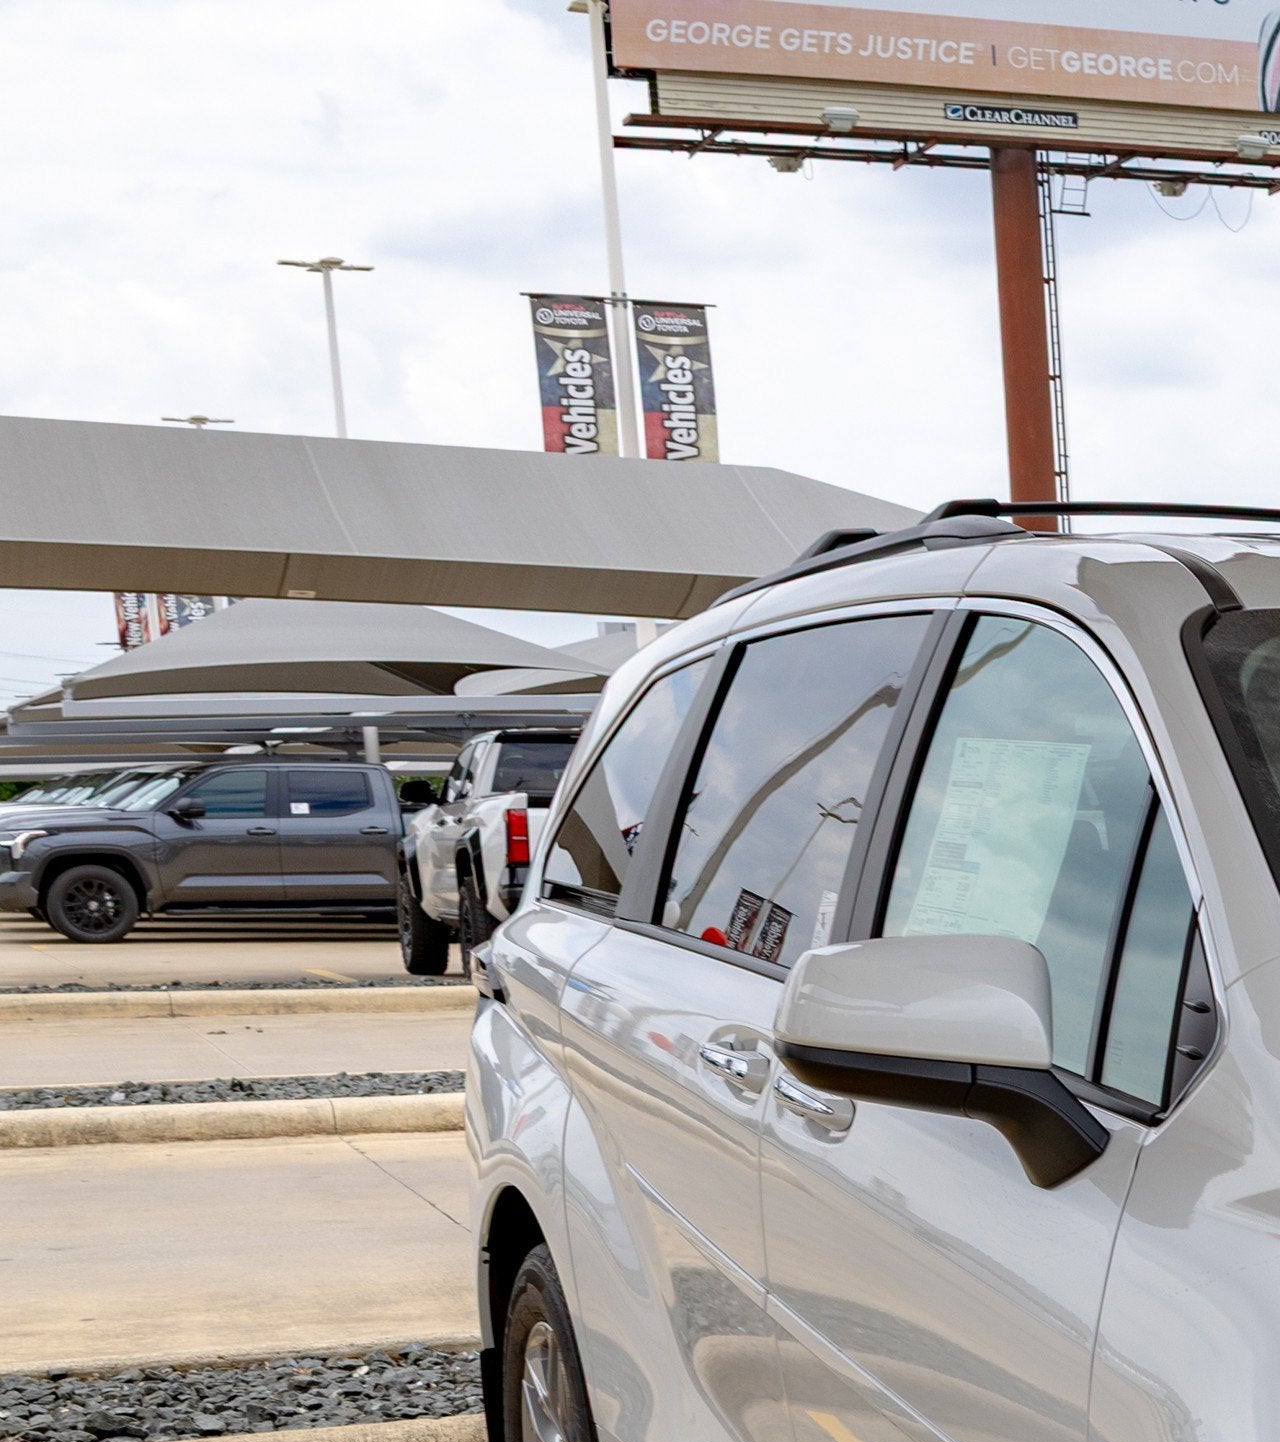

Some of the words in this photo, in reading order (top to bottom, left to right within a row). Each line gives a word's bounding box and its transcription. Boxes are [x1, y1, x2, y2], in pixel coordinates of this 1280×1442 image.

[645, 18, 772, 49] GEORGE
[779, 28, 853, 55] GETS
[859, 34, 976, 65] JUSTICE
[1007, 45, 1240, 87] GETGEORGE.COM
[558, 348, 599, 455] Vehicles
[659, 354, 700, 461] Vehicles
